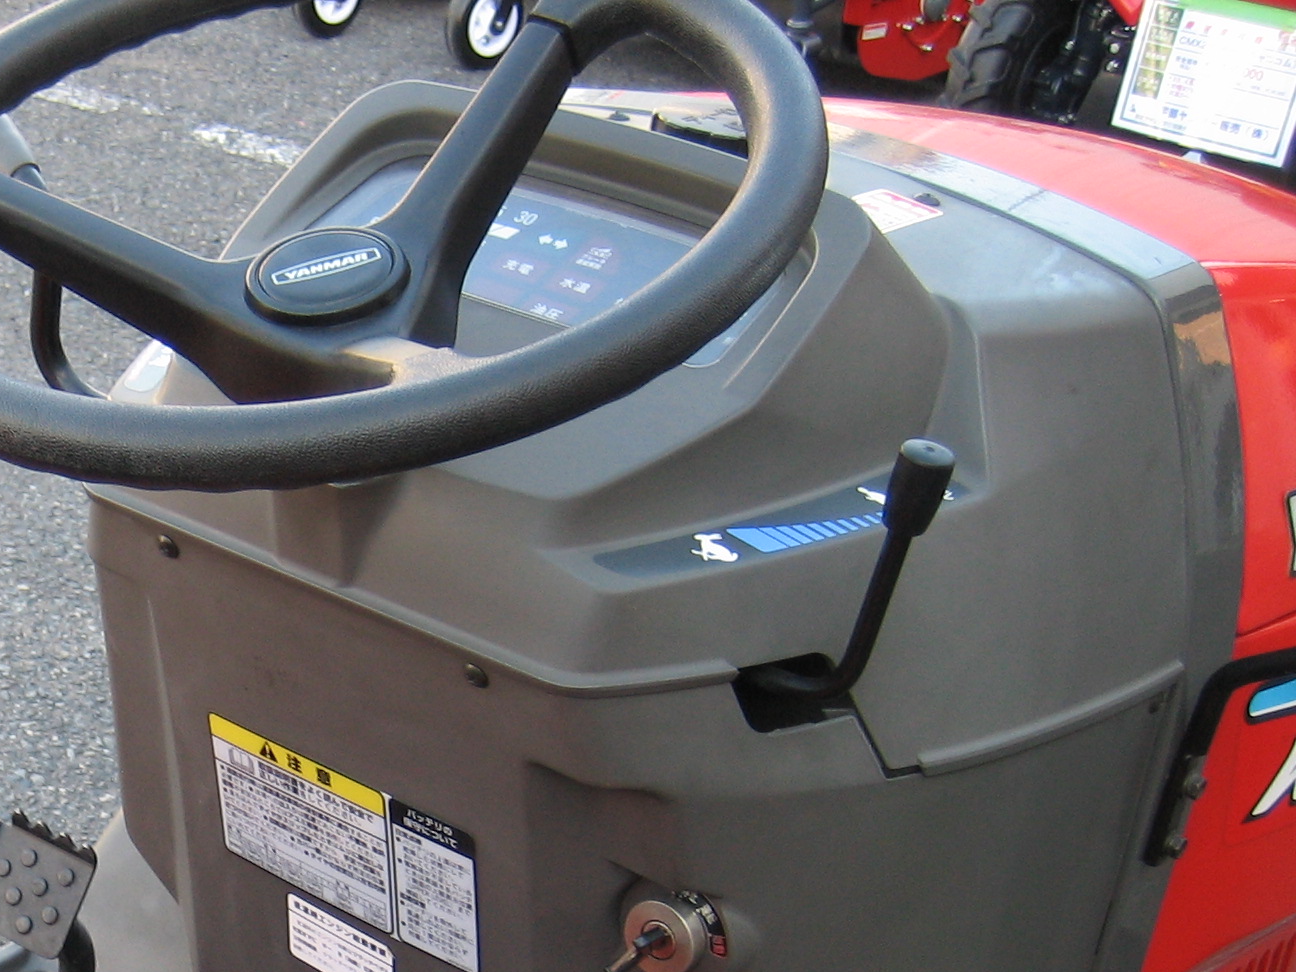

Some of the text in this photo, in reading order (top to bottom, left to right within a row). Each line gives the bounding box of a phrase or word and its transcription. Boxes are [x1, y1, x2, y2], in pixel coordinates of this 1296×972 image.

[513, 209, 539, 226] 30
[284, 251, 369, 280] YANMAR
[559, 278, 591, 294] 水温
[286, 752, 332, 788] 注意
